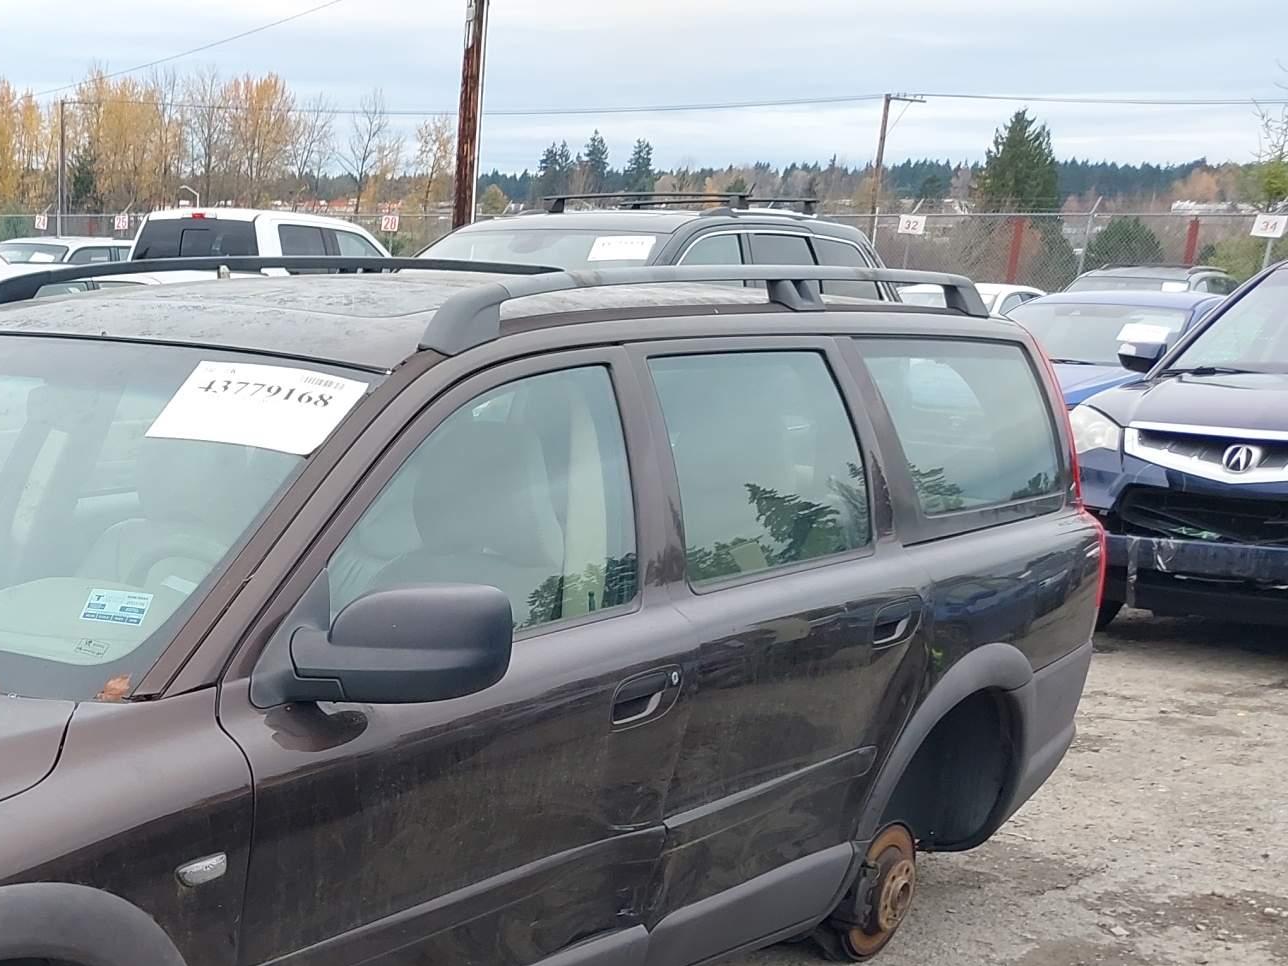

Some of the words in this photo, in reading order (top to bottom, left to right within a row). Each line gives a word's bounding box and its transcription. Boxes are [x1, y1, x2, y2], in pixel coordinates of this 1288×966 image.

[36, 216, 46, 228] 24
[383, 216, 397, 229] 28
[904, 220, 919, 230] 32
[1261, 221, 1278, 232] 34
[198, 379, 334, 408] 43779168
